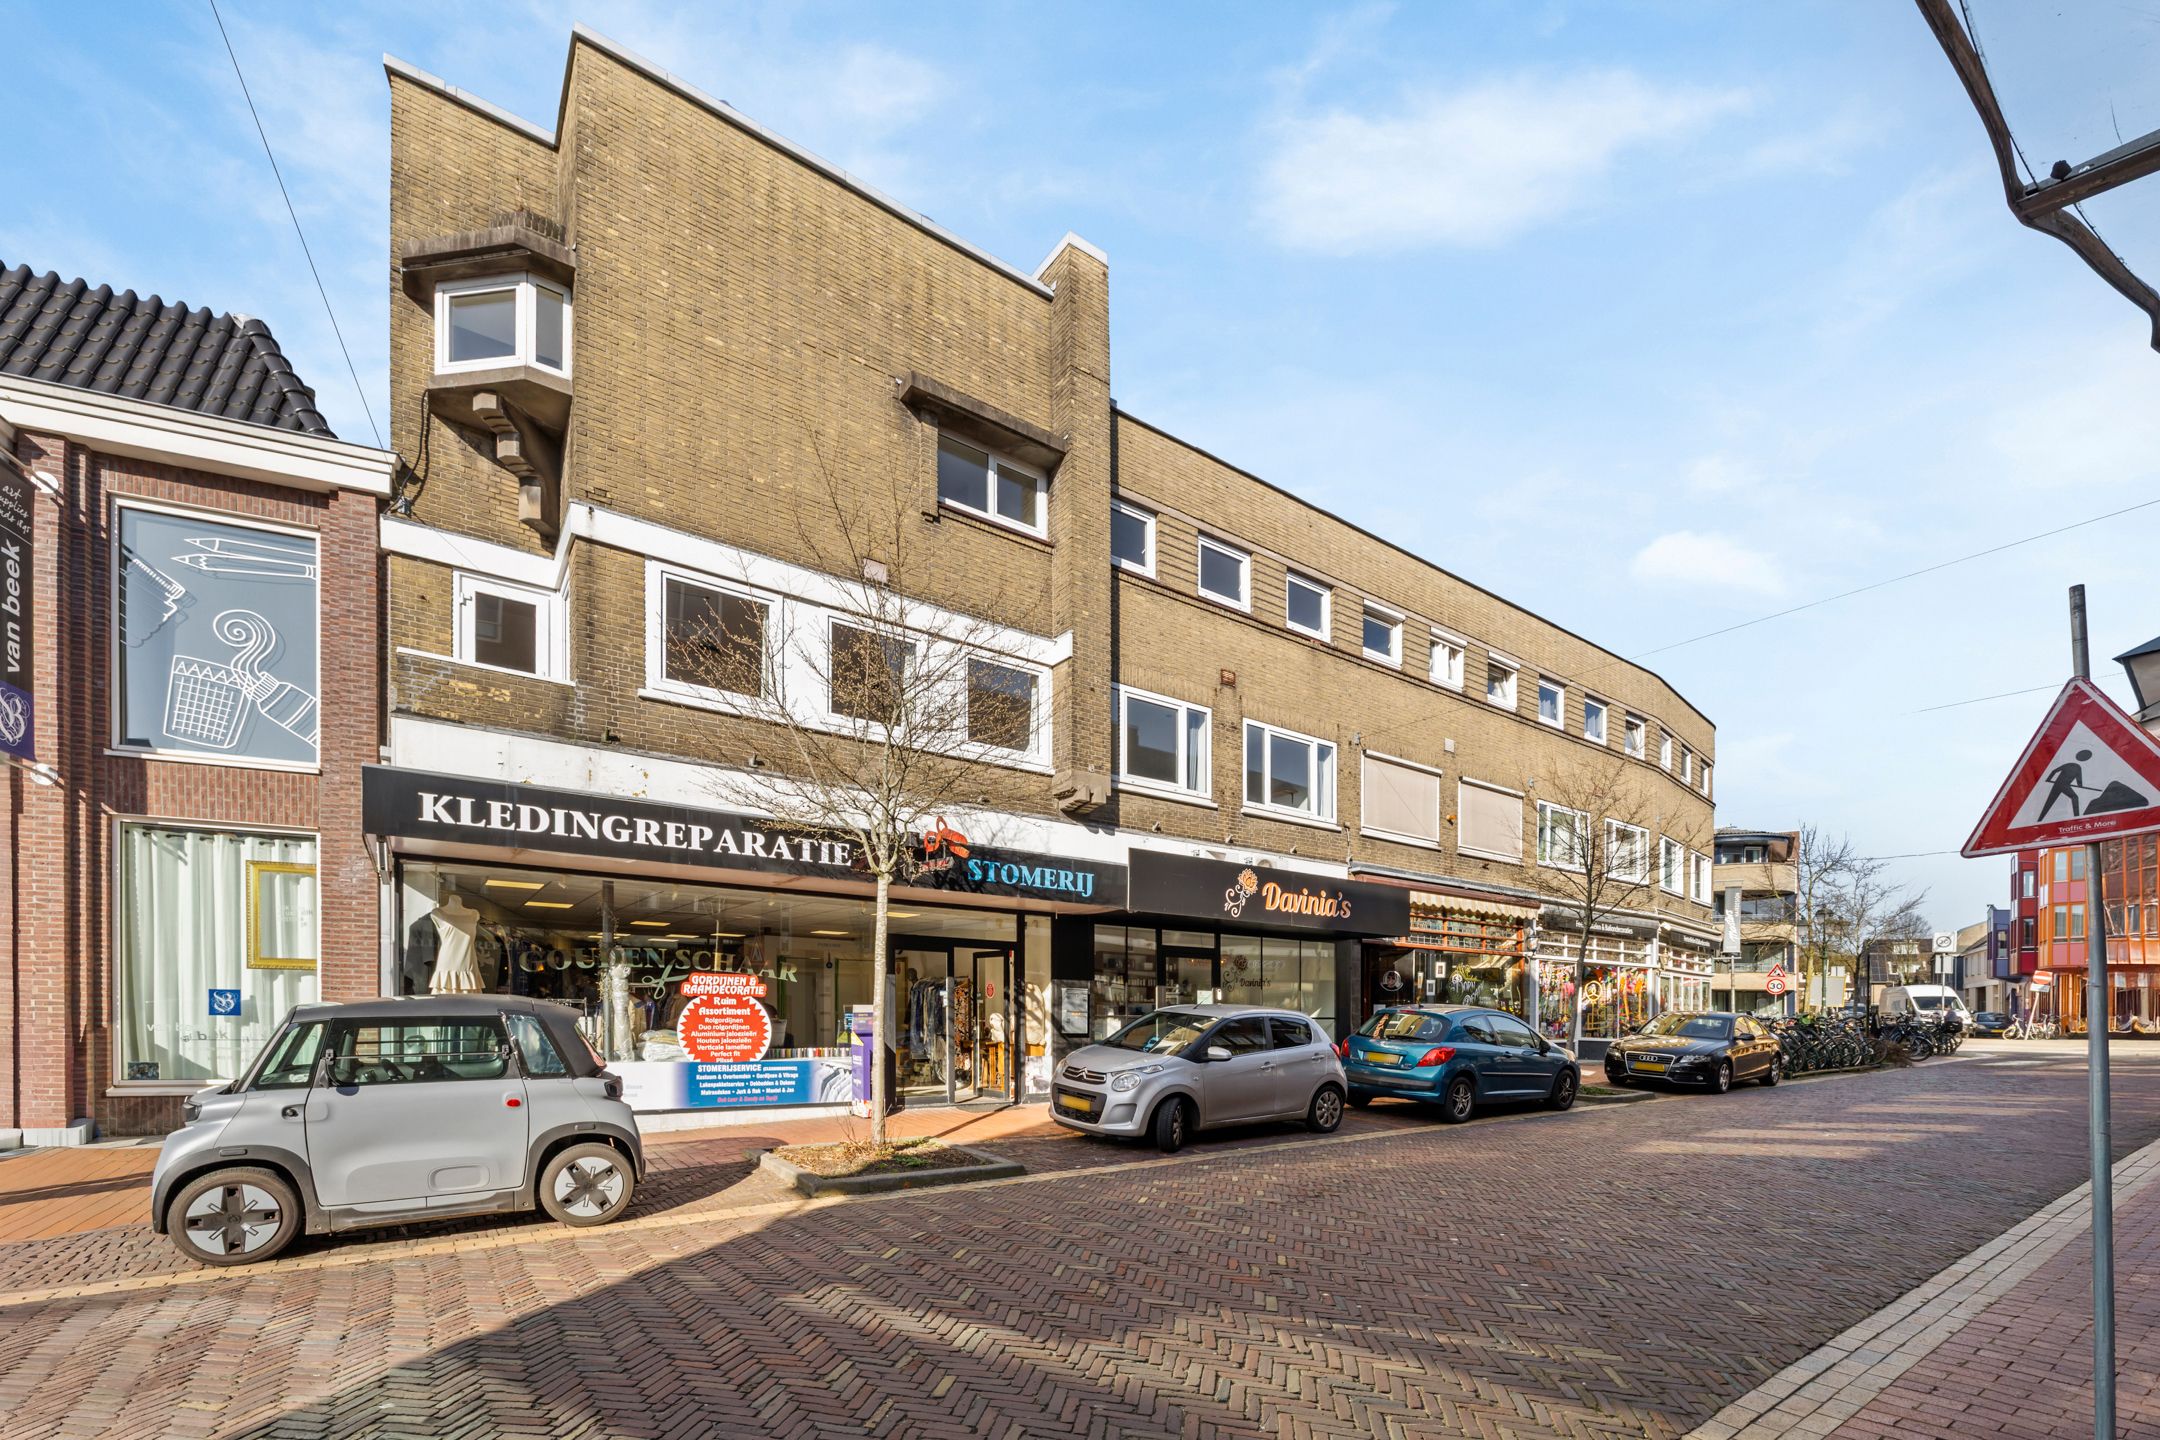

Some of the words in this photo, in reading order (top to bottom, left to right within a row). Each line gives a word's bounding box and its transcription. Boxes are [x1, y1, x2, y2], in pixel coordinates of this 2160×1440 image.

[1, 539, 21, 617] beek
[7, 623, 21, 673] van
[417, 791, 852, 867] KLEDINGREPARATIE
[2058, 825, 2083, 833] Traffic
[2094, 820, 2117, 828] More
[967, 858, 1095, 897] STOMERIJ
[1261, 881, 1352, 919] Davinia's
[683, 984, 765, 995] RAAMDECORATIE
[691, 975, 747, 986] GORDIJNEN
[749, 977, 757, 985] &
[698, 1006, 751, 1015] Assortiment
[698, 1064, 762, 1072] STOMERIJSERVICE
